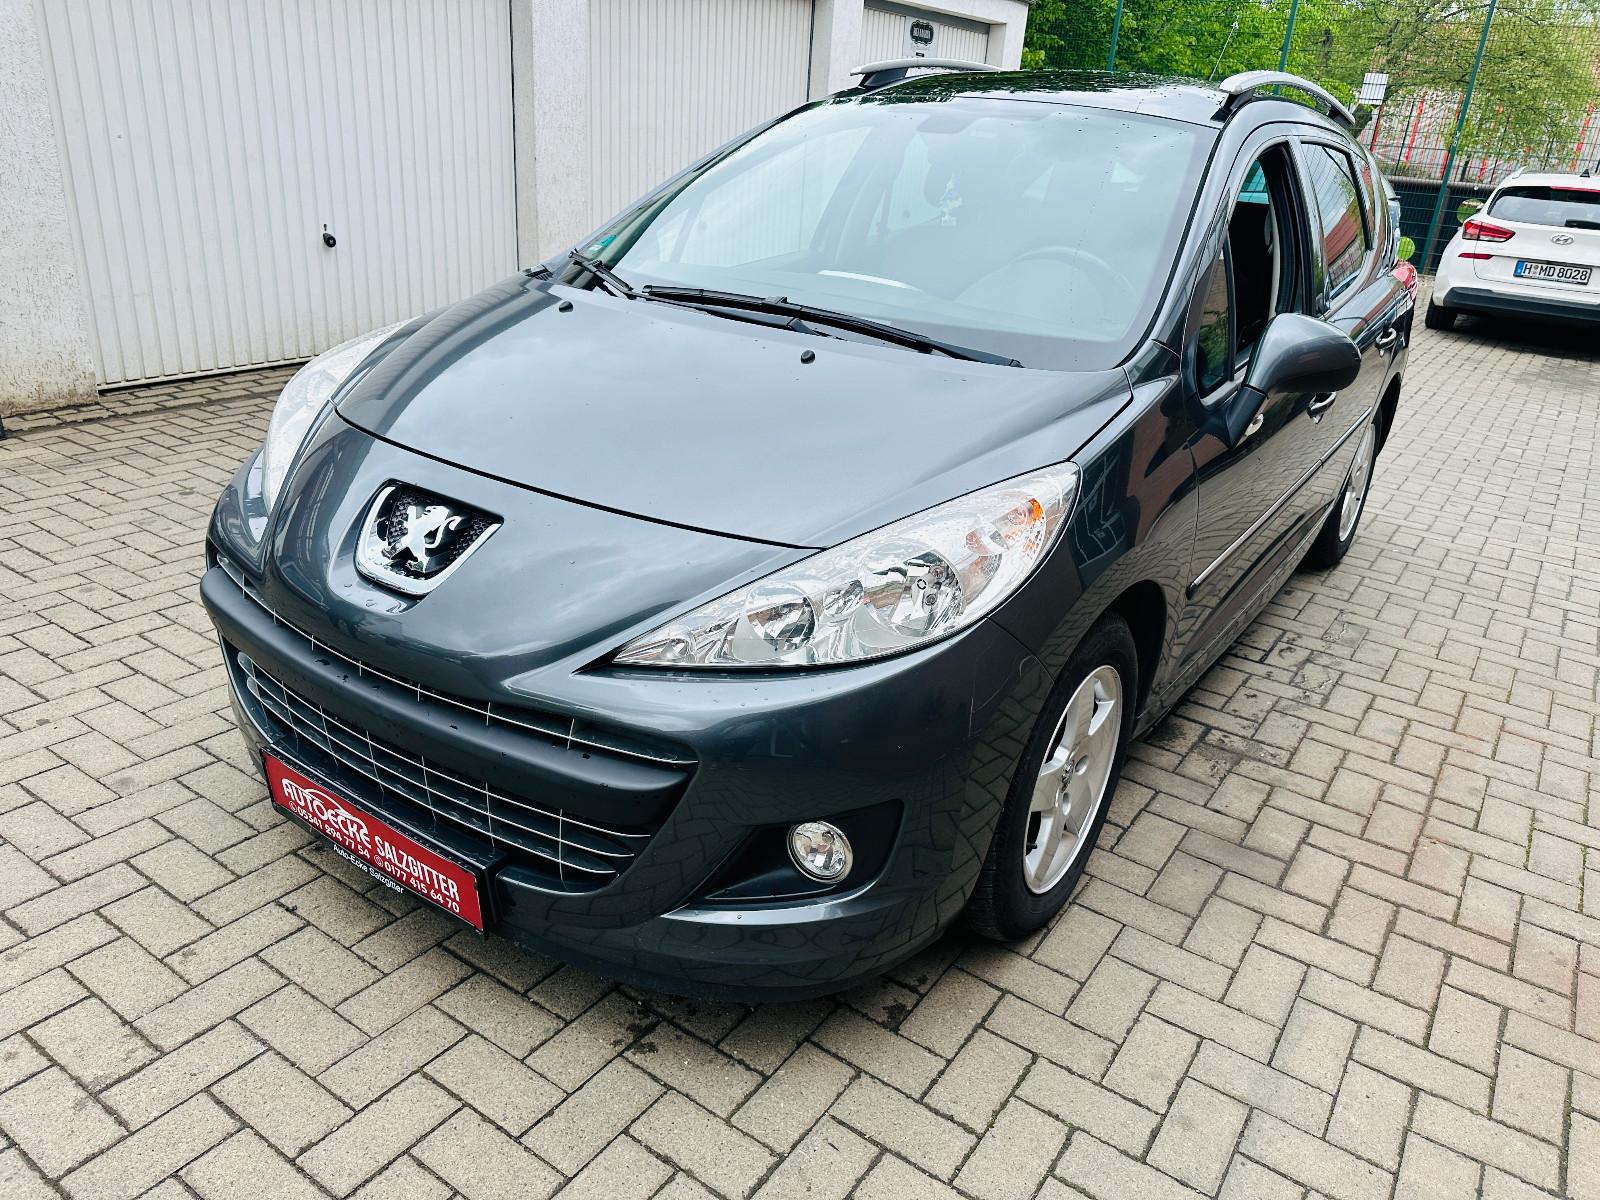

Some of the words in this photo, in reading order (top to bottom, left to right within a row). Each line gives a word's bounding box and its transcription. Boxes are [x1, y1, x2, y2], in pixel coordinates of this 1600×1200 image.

[1523, 264, 1533, 275] H
[1538, 265, 1555, 278] MD
[1557, 267, 1588, 281] 8028
[297, 807, 323, 830] 05341
[324, 824, 342, 842] 294
[343, 836, 355, 849] 77
[357, 844, 371, 859] 54
[384, 861, 407, 882] 0177
[409, 877, 428, 894] 415
[430, 889, 444, 904] 64
[445, 899, 460, 913] 70
[333, 844, 368, 873] Auto-Ecke
[369, 867, 405, 894] Salzgitter
[374, 835, 460, 902] SALZGITTER
